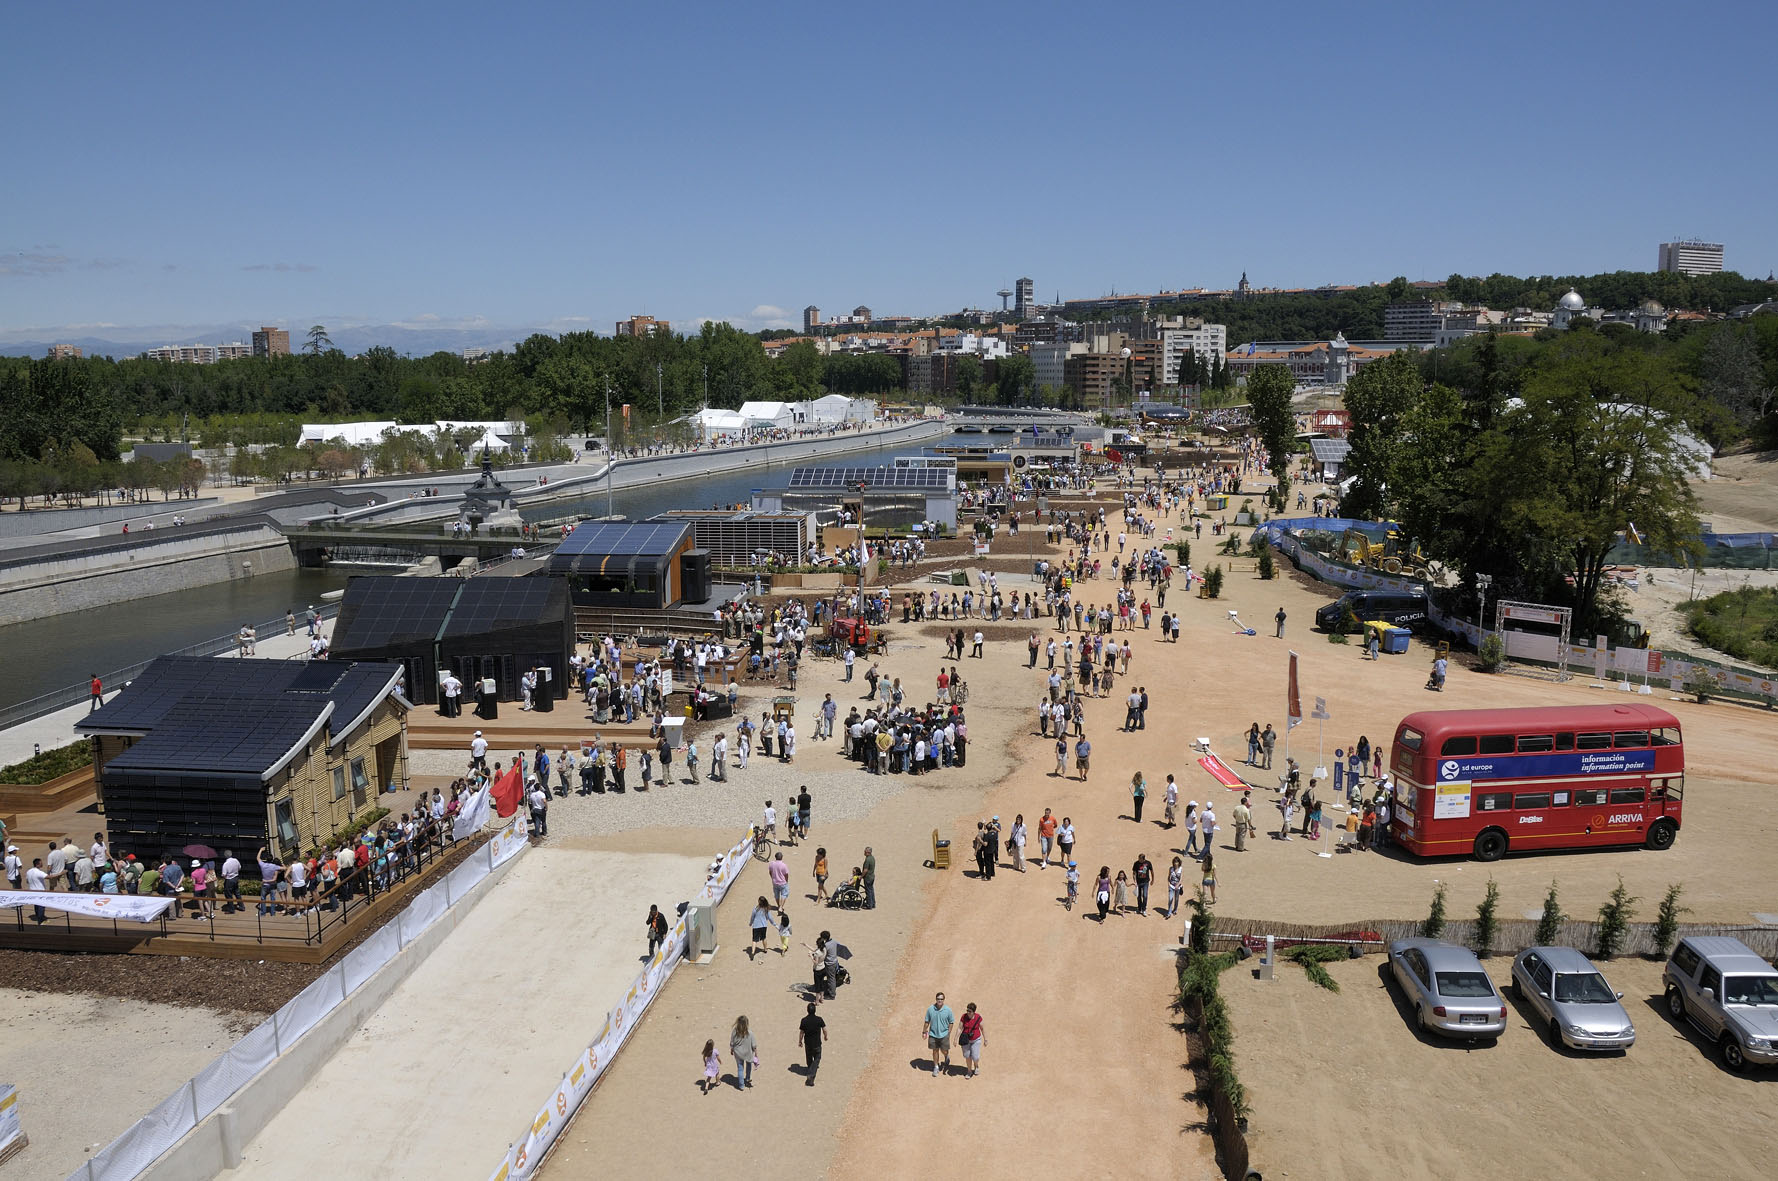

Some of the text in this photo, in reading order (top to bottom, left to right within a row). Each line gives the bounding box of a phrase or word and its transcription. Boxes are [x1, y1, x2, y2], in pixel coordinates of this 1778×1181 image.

[1395, 612, 1425, 622] POLICIA
[1581, 754, 1625, 763] información
[1581, 761, 1645, 773] information point
[1608, 813, 1643, 824] ARRIVA
